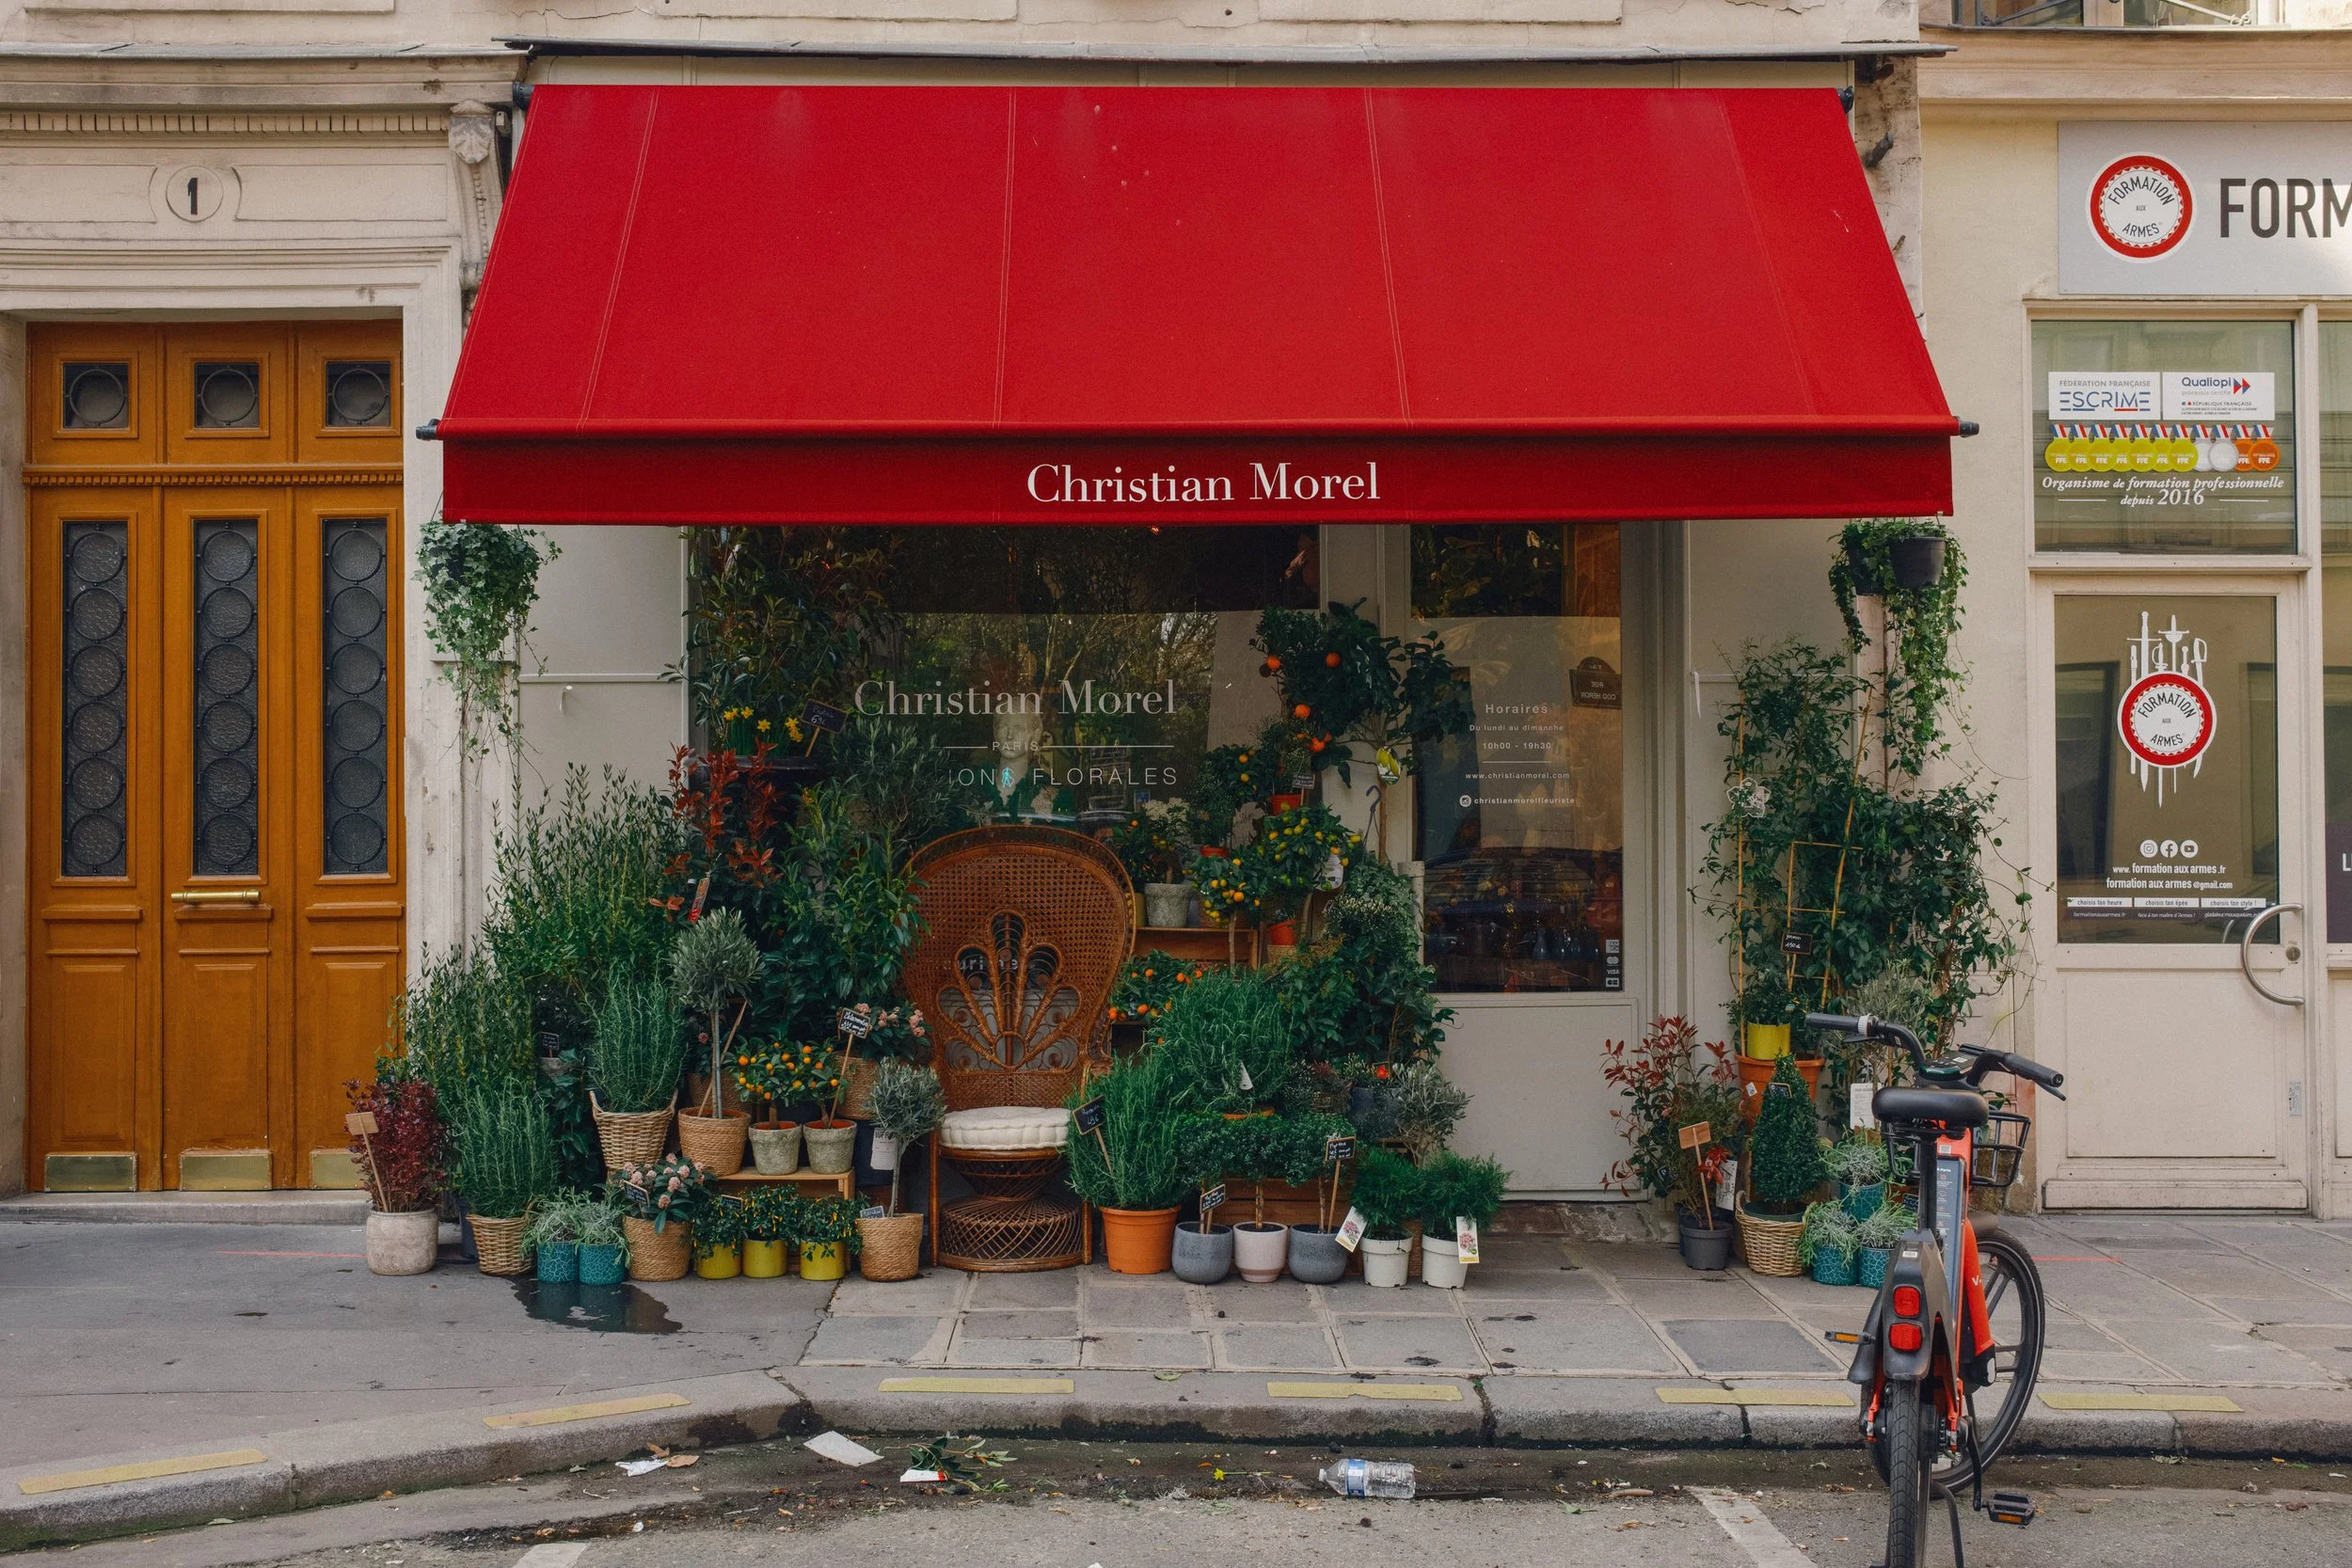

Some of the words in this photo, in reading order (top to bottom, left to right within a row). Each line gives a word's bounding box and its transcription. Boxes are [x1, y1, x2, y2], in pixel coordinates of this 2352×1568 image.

[187, 177, 198, 215] 1
[2107, 176, 2175, 205] FORMATION
[2219, 178, 2352, 238] FORM
[2122, 223, 2160, 237] ARMES
[2108, 379, 2151, 388] FRANÇAISE
[2182, 376, 2232, 388] Qualiopi
[2059, 391, 2151, 411] ESCRIME
[1026, 464, 1235, 503] Christian
[1248, 462, 1381, 500] Morel
[2042, 476, 2109, 490] Organisme
[2113, 478, 2125, 488] de
[2126, 475, 2190, 491] formation
[2192, 475, 2284, 491] professionnelle
[2120, 494, 2153, 507] depuis
[2157, 488, 2204, 506] 2016
[854, 678, 1041, 716] Christian
[1057, 678, 1176, 715] Morel
[1485, 704, 1549, 714] Horaires
[2137, 692, 2197, 718] FORMATION
[993, 741, 1039, 751] PARIS
[1482, 741, 1511, 750] 10h00
[1523, 741, 1551, 750] 19h30
[2150, 734, 2184, 747] ARMES
[1033, 767, 1177, 785] FLORALES
[2132, 863, 2172, 874] formation
[2173, 865, 2189, 874] aux
[2189, 865, 2217, 874] armes
[2106, 878, 2147, 889] formation
[2148, 880, 2164, 889] aux
[2165, 880, 2192, 889] armes
[2193, 879, 2233, 891] @gmail.com
[2077, 897, 2096, 906] choisis
[2107, 897, 2122, 906] heure
